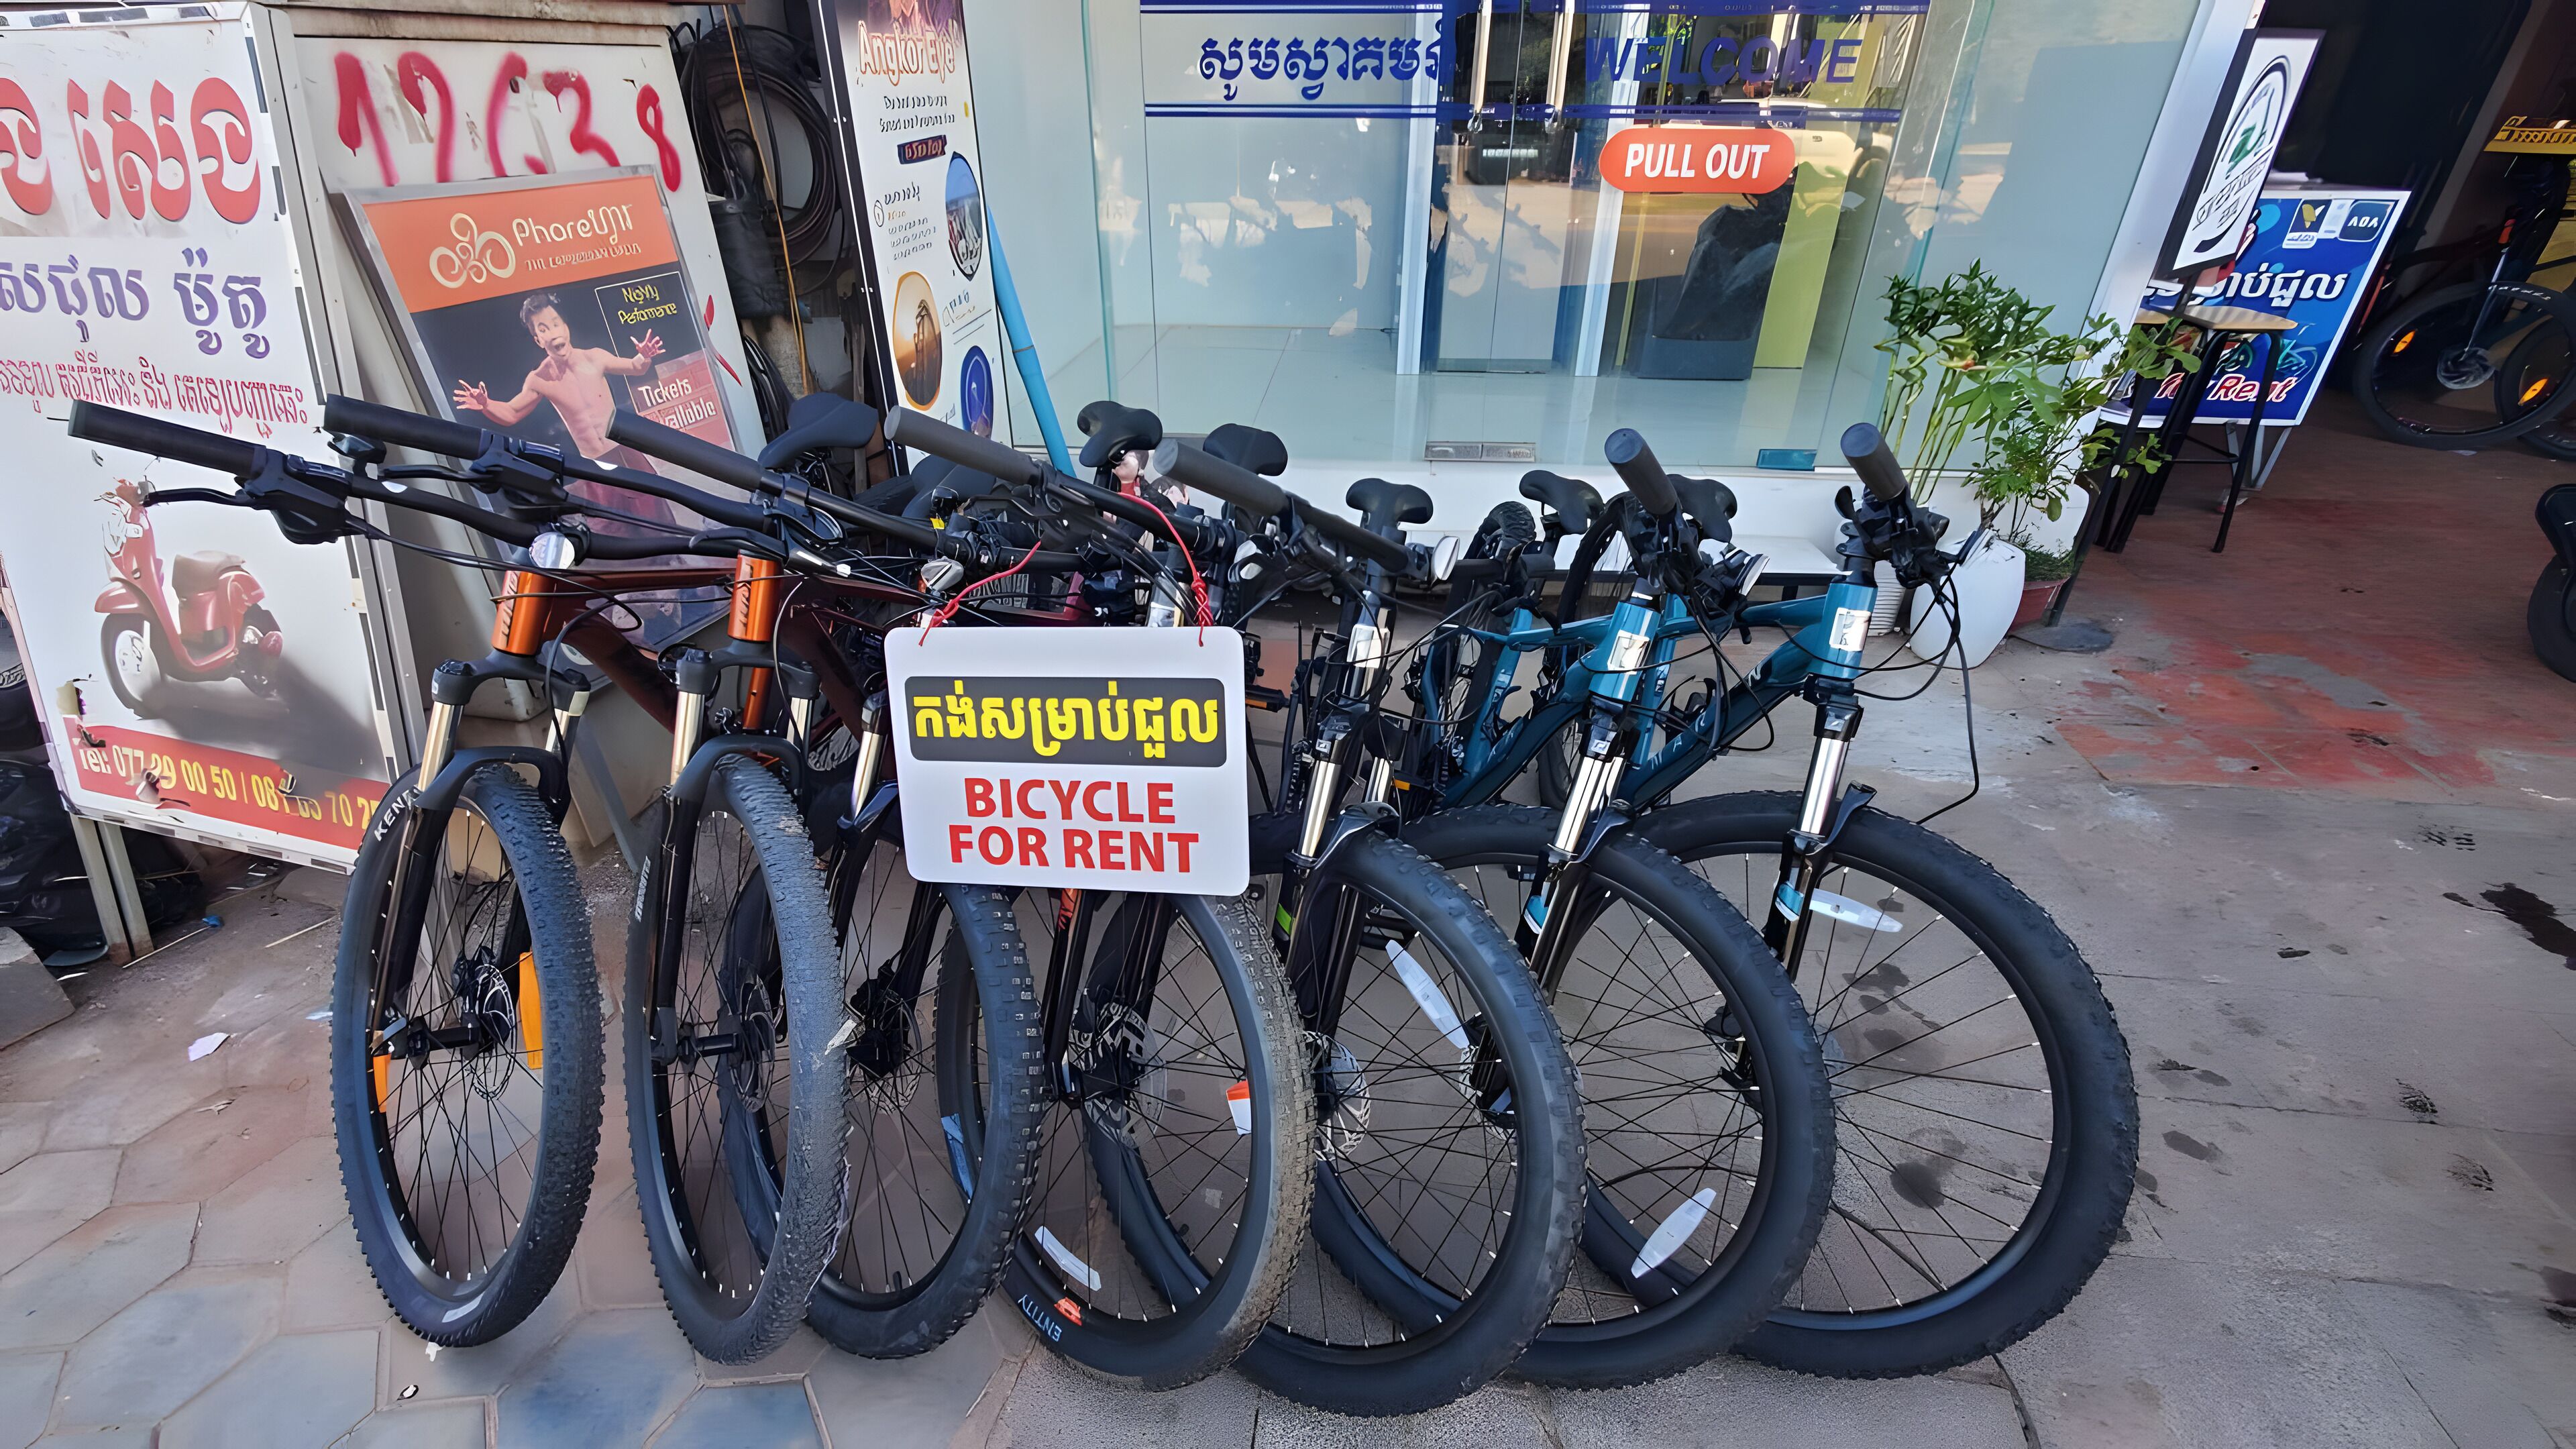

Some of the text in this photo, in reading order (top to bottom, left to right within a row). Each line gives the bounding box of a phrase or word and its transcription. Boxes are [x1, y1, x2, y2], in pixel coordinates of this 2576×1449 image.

[858, 20, 955, 87] Angkor Eye
[1585, 36, 1863, 85] WELCOME
[1625, 142, 1770, 180] PULL OUT
[512, 217, 593, 247] Phare
[173, 247, 270, 360] ម៉ូតូ
[638, 377, 692, 408] Tickets
[661, 397, 717, 429] ailable
[912, 680, 1218, 759] កង់សម្រាប់ជួល
[180, 759, 207, 795] 00
[210, 765, 237, 801] 50
[964, 777, 1176, 824] BICYCLE
[949, 824, 1199, 873] FOR RENT
[1017, 1294, 1063, 1342] ENTITY
